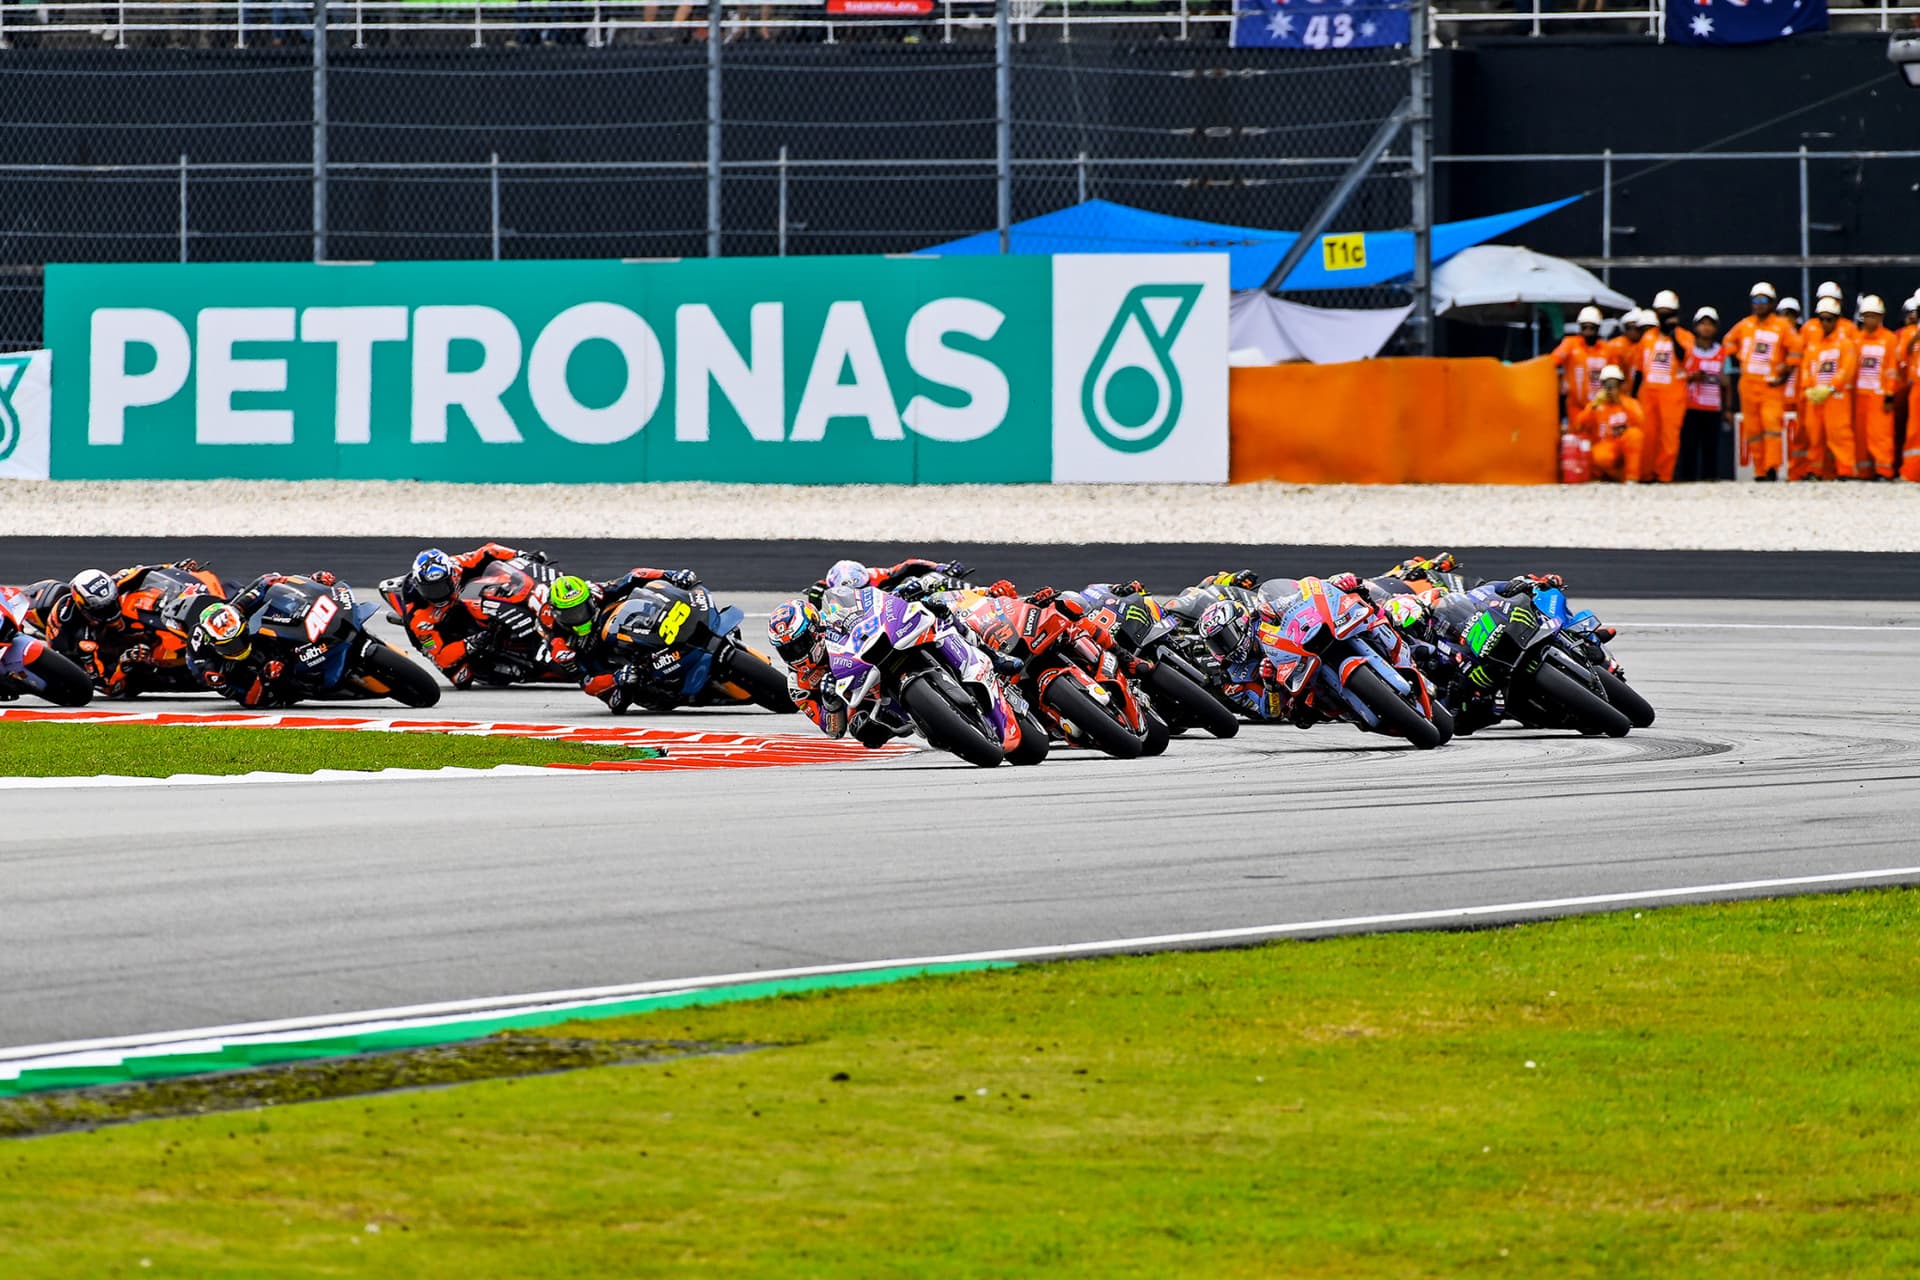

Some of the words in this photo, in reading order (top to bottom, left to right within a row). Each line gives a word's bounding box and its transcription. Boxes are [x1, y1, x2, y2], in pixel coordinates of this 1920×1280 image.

[1303, 13, 1354, 49] 43
[1325, 242, 1363, 265] T1c
[88, 297, 1010, 445] PETRONAS
[305, 594, 338, 643] 40
[659, 600, 691, 645] 35
[1023, 608, 1038, 636] Lenovo
[1286, 606, 1324, 646] 23
[1461, 610, 1483, 638] ENEOS
[1466, 610, 1497, 655] 21
